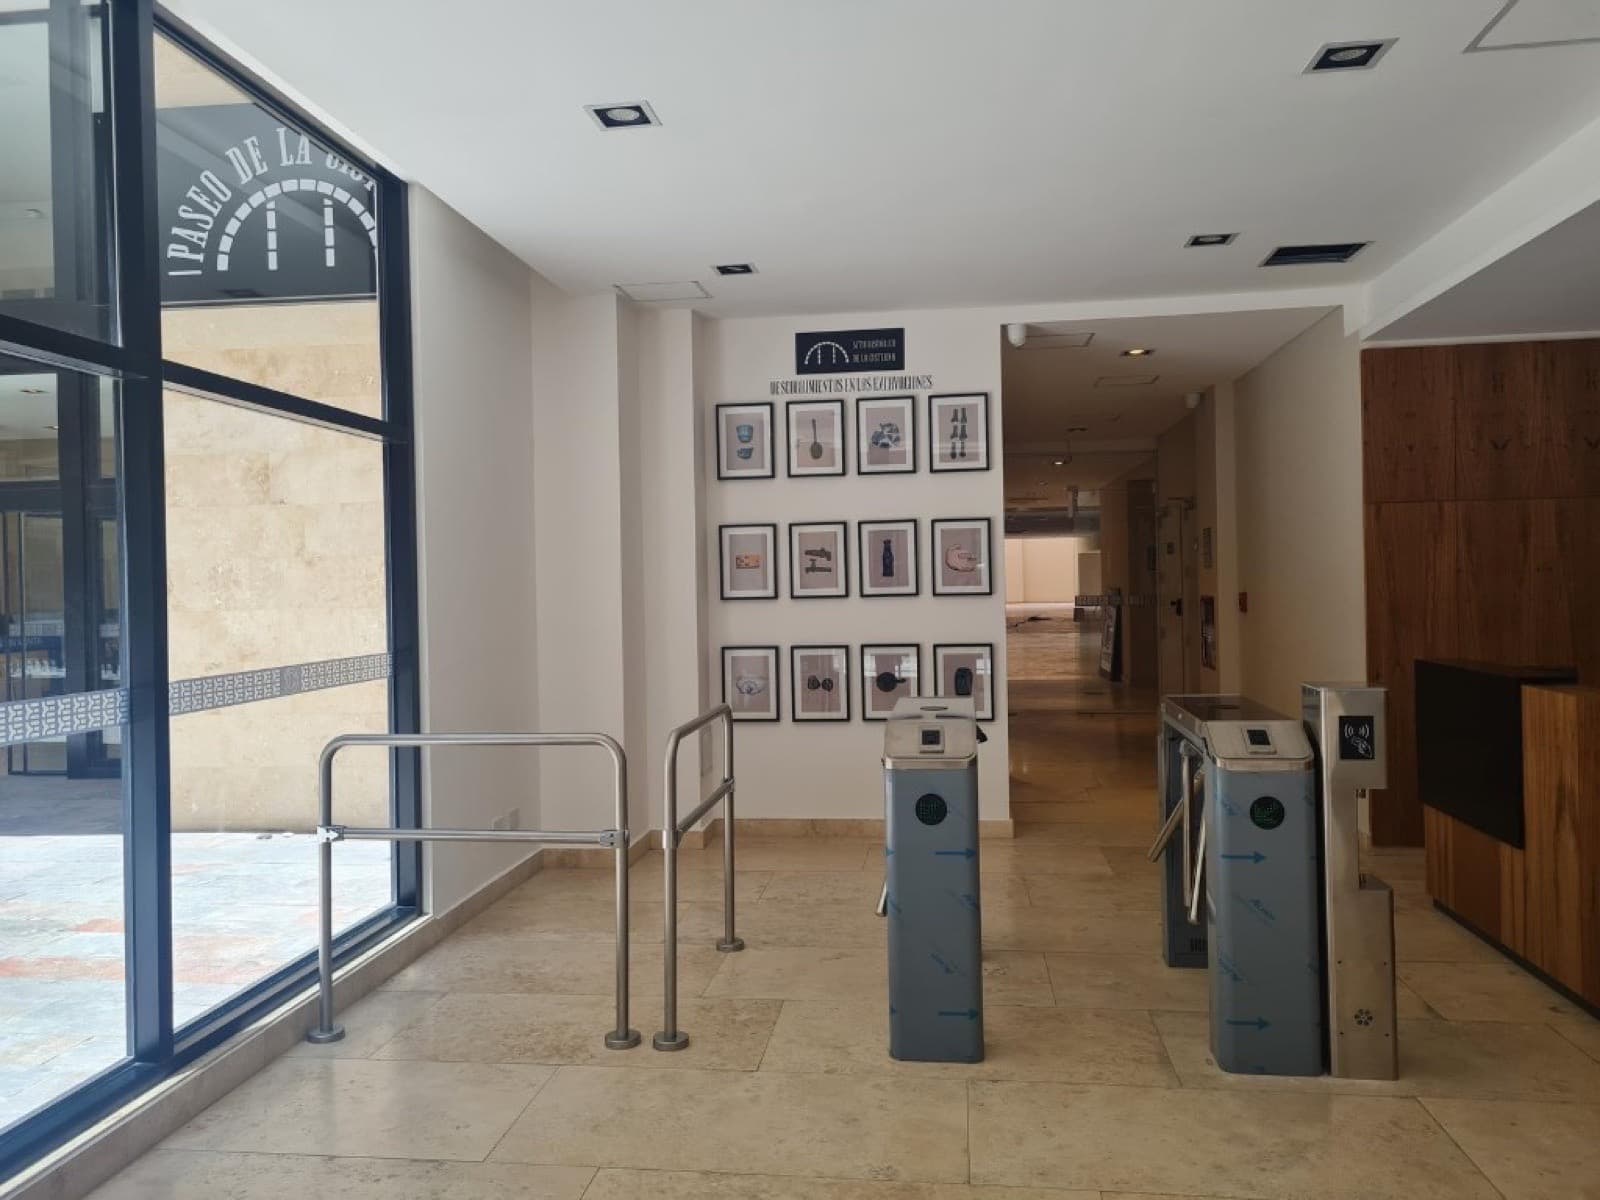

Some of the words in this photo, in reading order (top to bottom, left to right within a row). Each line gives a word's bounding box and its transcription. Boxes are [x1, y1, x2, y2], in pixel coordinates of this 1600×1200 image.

[167, 169, 232, 263] PASEO
[225, 135, 269, 185] DE
[276, 127, 312, 167] LA
[769, 378, 843, 395] DESCIMIENTS
[857, 376, 872, 392] LS
